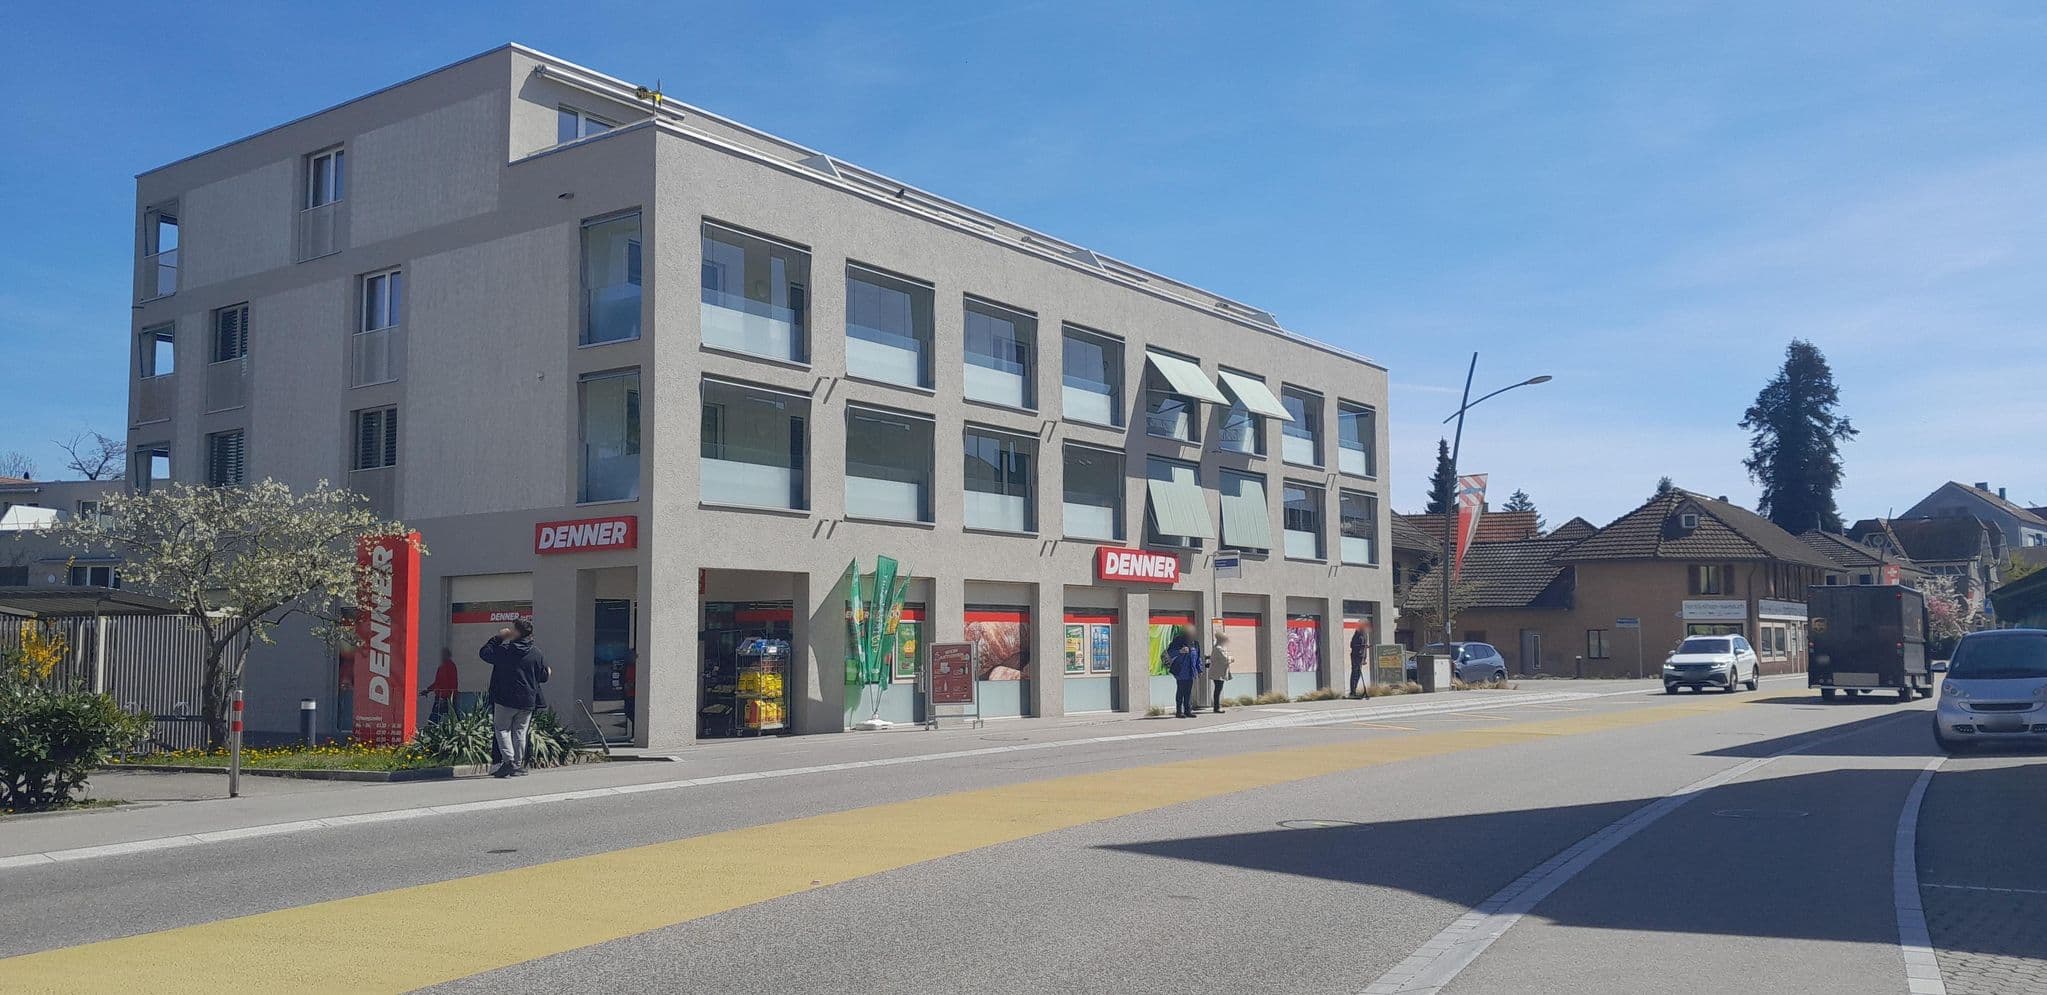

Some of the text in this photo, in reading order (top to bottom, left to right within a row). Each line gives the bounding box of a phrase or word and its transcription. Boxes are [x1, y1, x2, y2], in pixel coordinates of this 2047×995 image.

[539, 521, 627, 549] DENNER
[1105, 552, 1176, 578] DENNER
[368, 545, 394, 706] DENNER
[490, 612, 520, 621] DENNER
